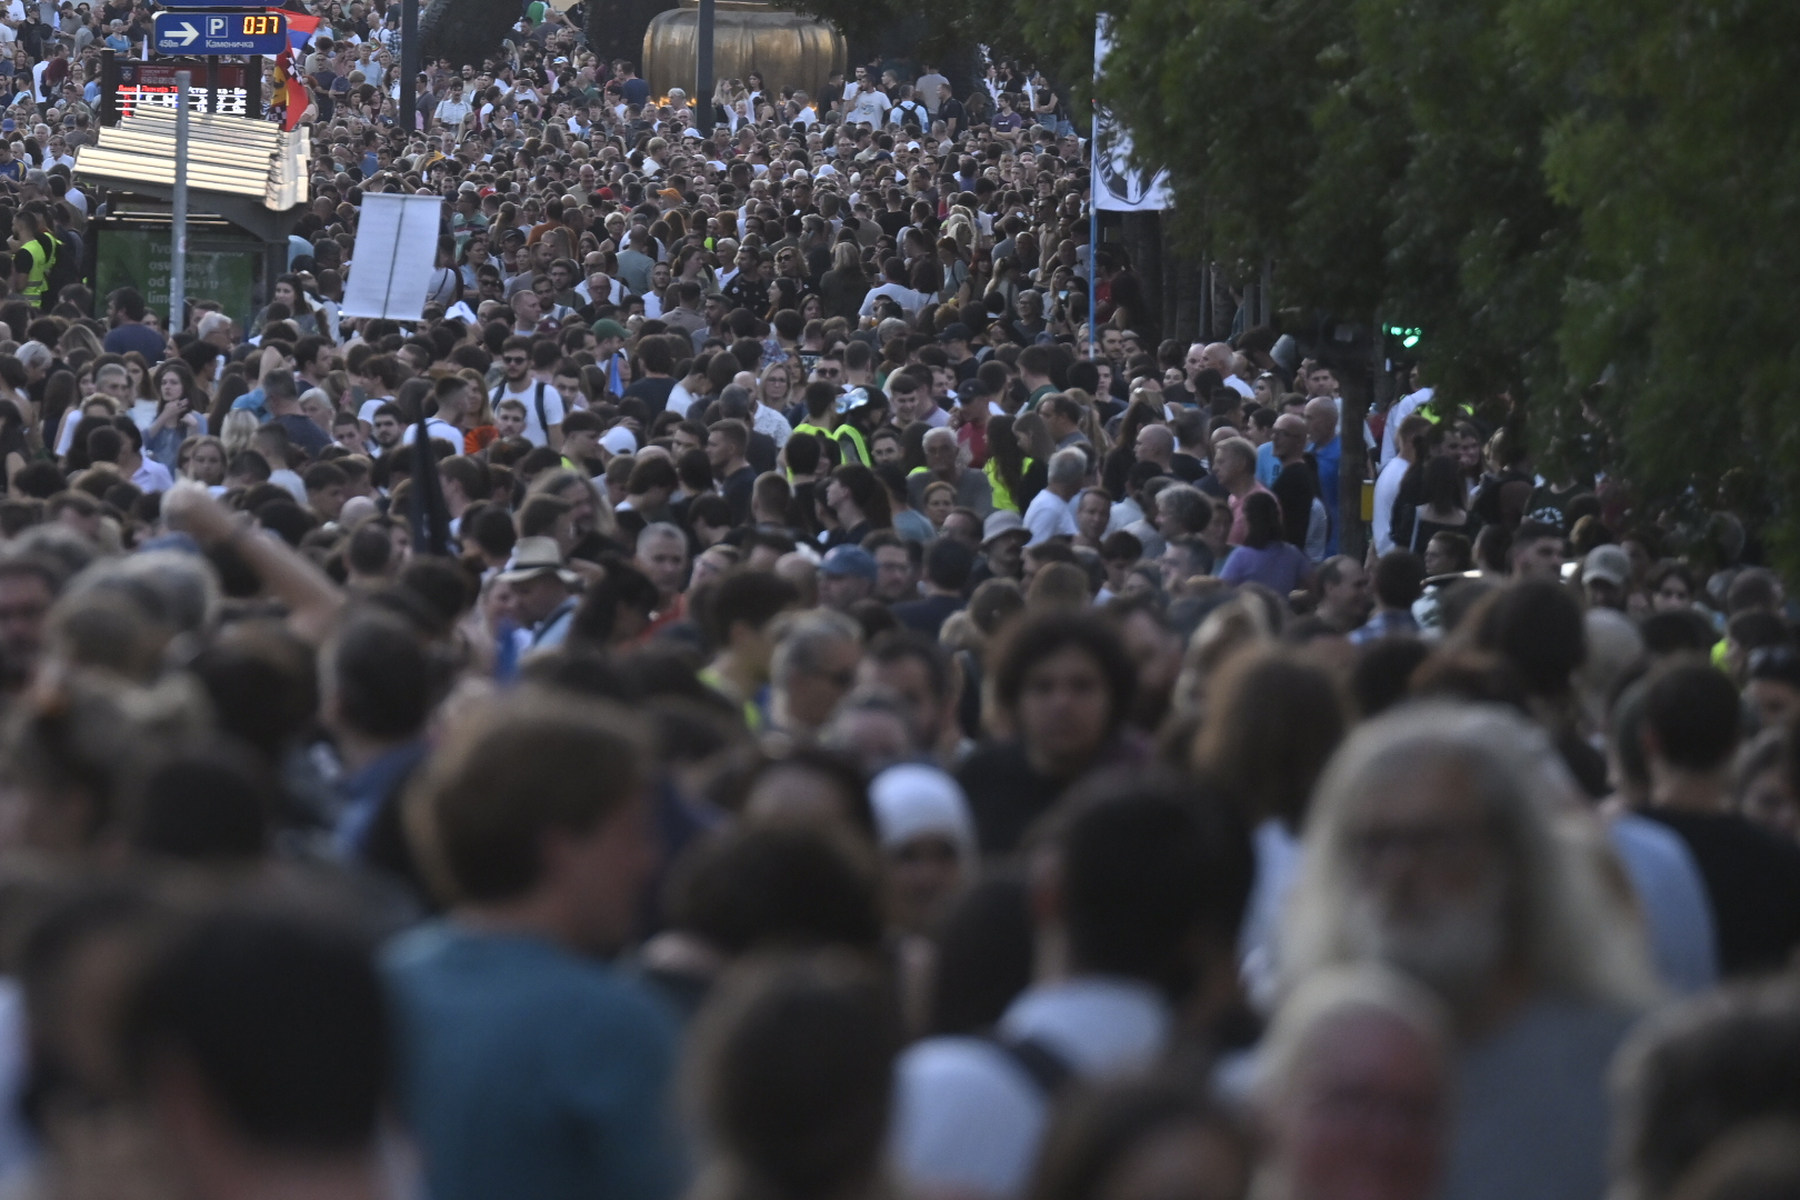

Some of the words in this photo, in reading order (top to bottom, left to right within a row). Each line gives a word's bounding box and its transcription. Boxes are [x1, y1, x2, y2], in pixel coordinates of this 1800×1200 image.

[243, 16, 279, 35] 037
[159, 39, 179, 48] 450m
[205, 39, 254, 49] Каменичка
